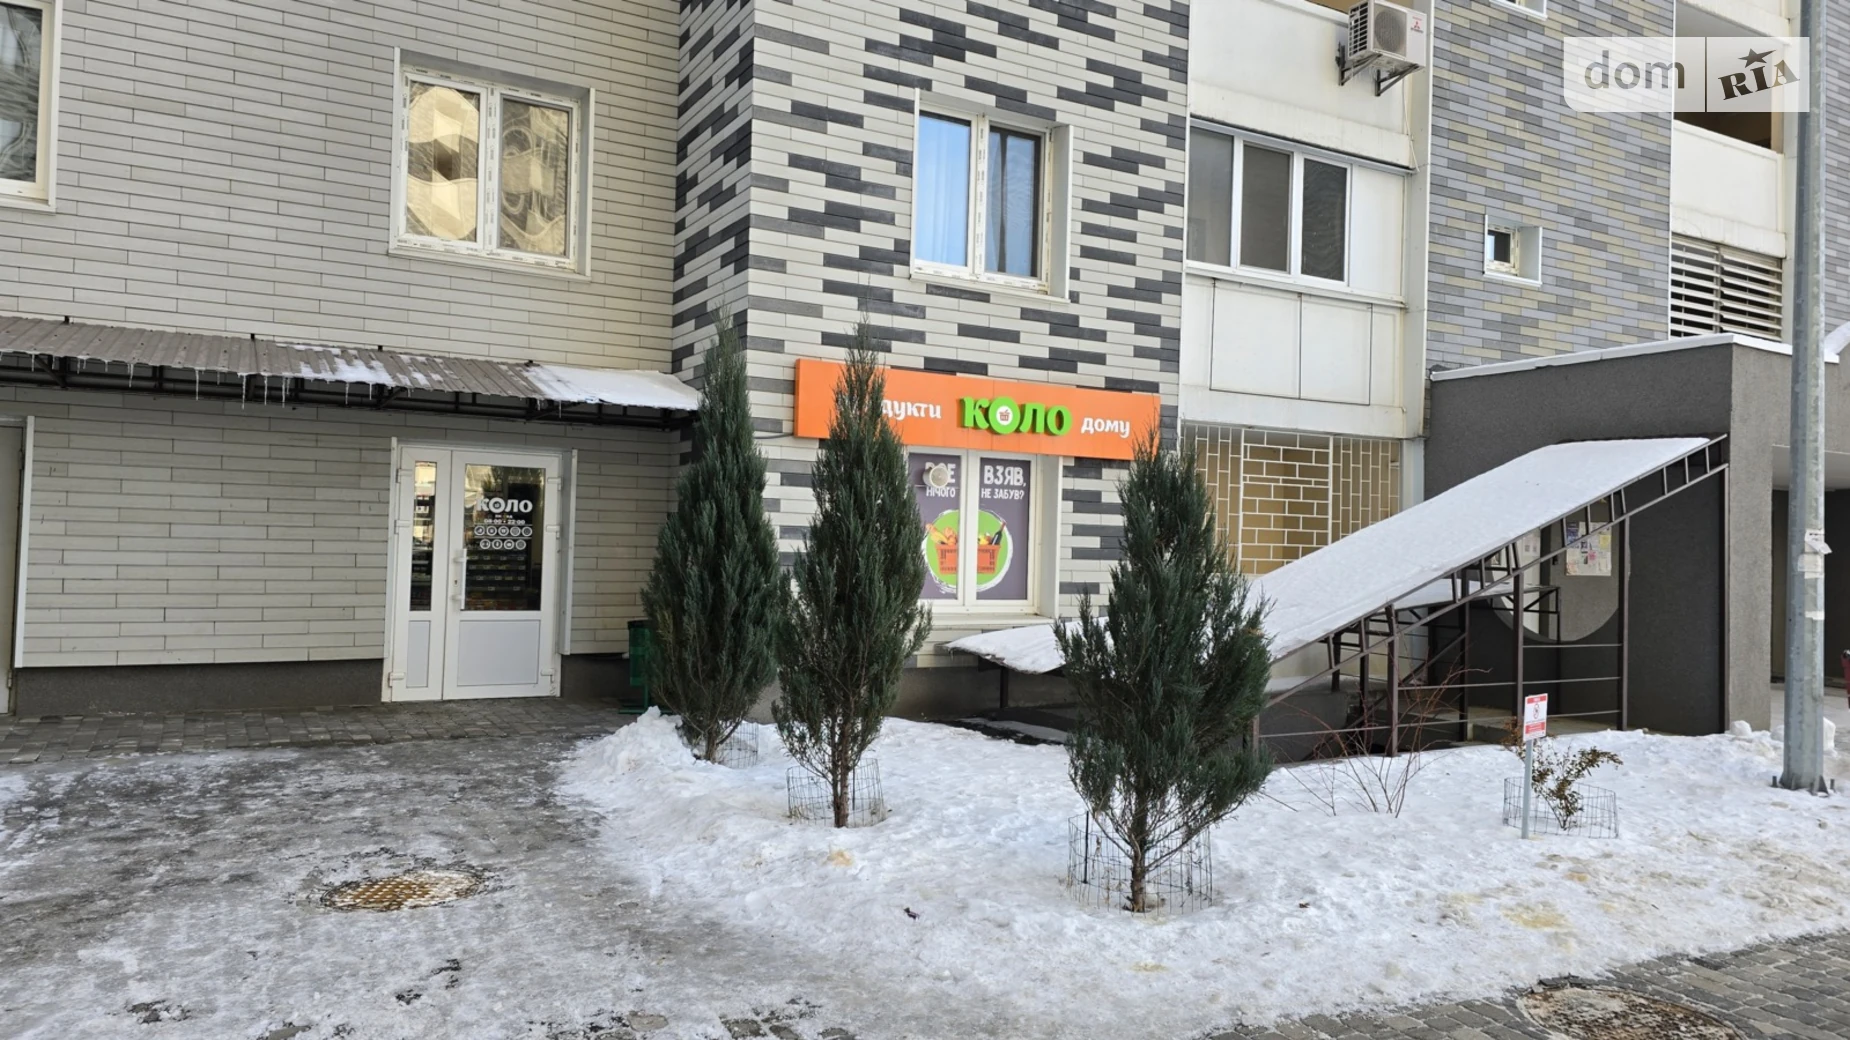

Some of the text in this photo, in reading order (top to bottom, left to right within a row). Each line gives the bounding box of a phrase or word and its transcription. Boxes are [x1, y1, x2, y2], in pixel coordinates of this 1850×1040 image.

[1081, 416, 1131, 439] дому
[983, 465, 1027, 487] ВЗЯВ,
[926, 486, 956, 498] НІЧОГО
[981, 488, 1025, 501] НЕ ЗАБУВ?
